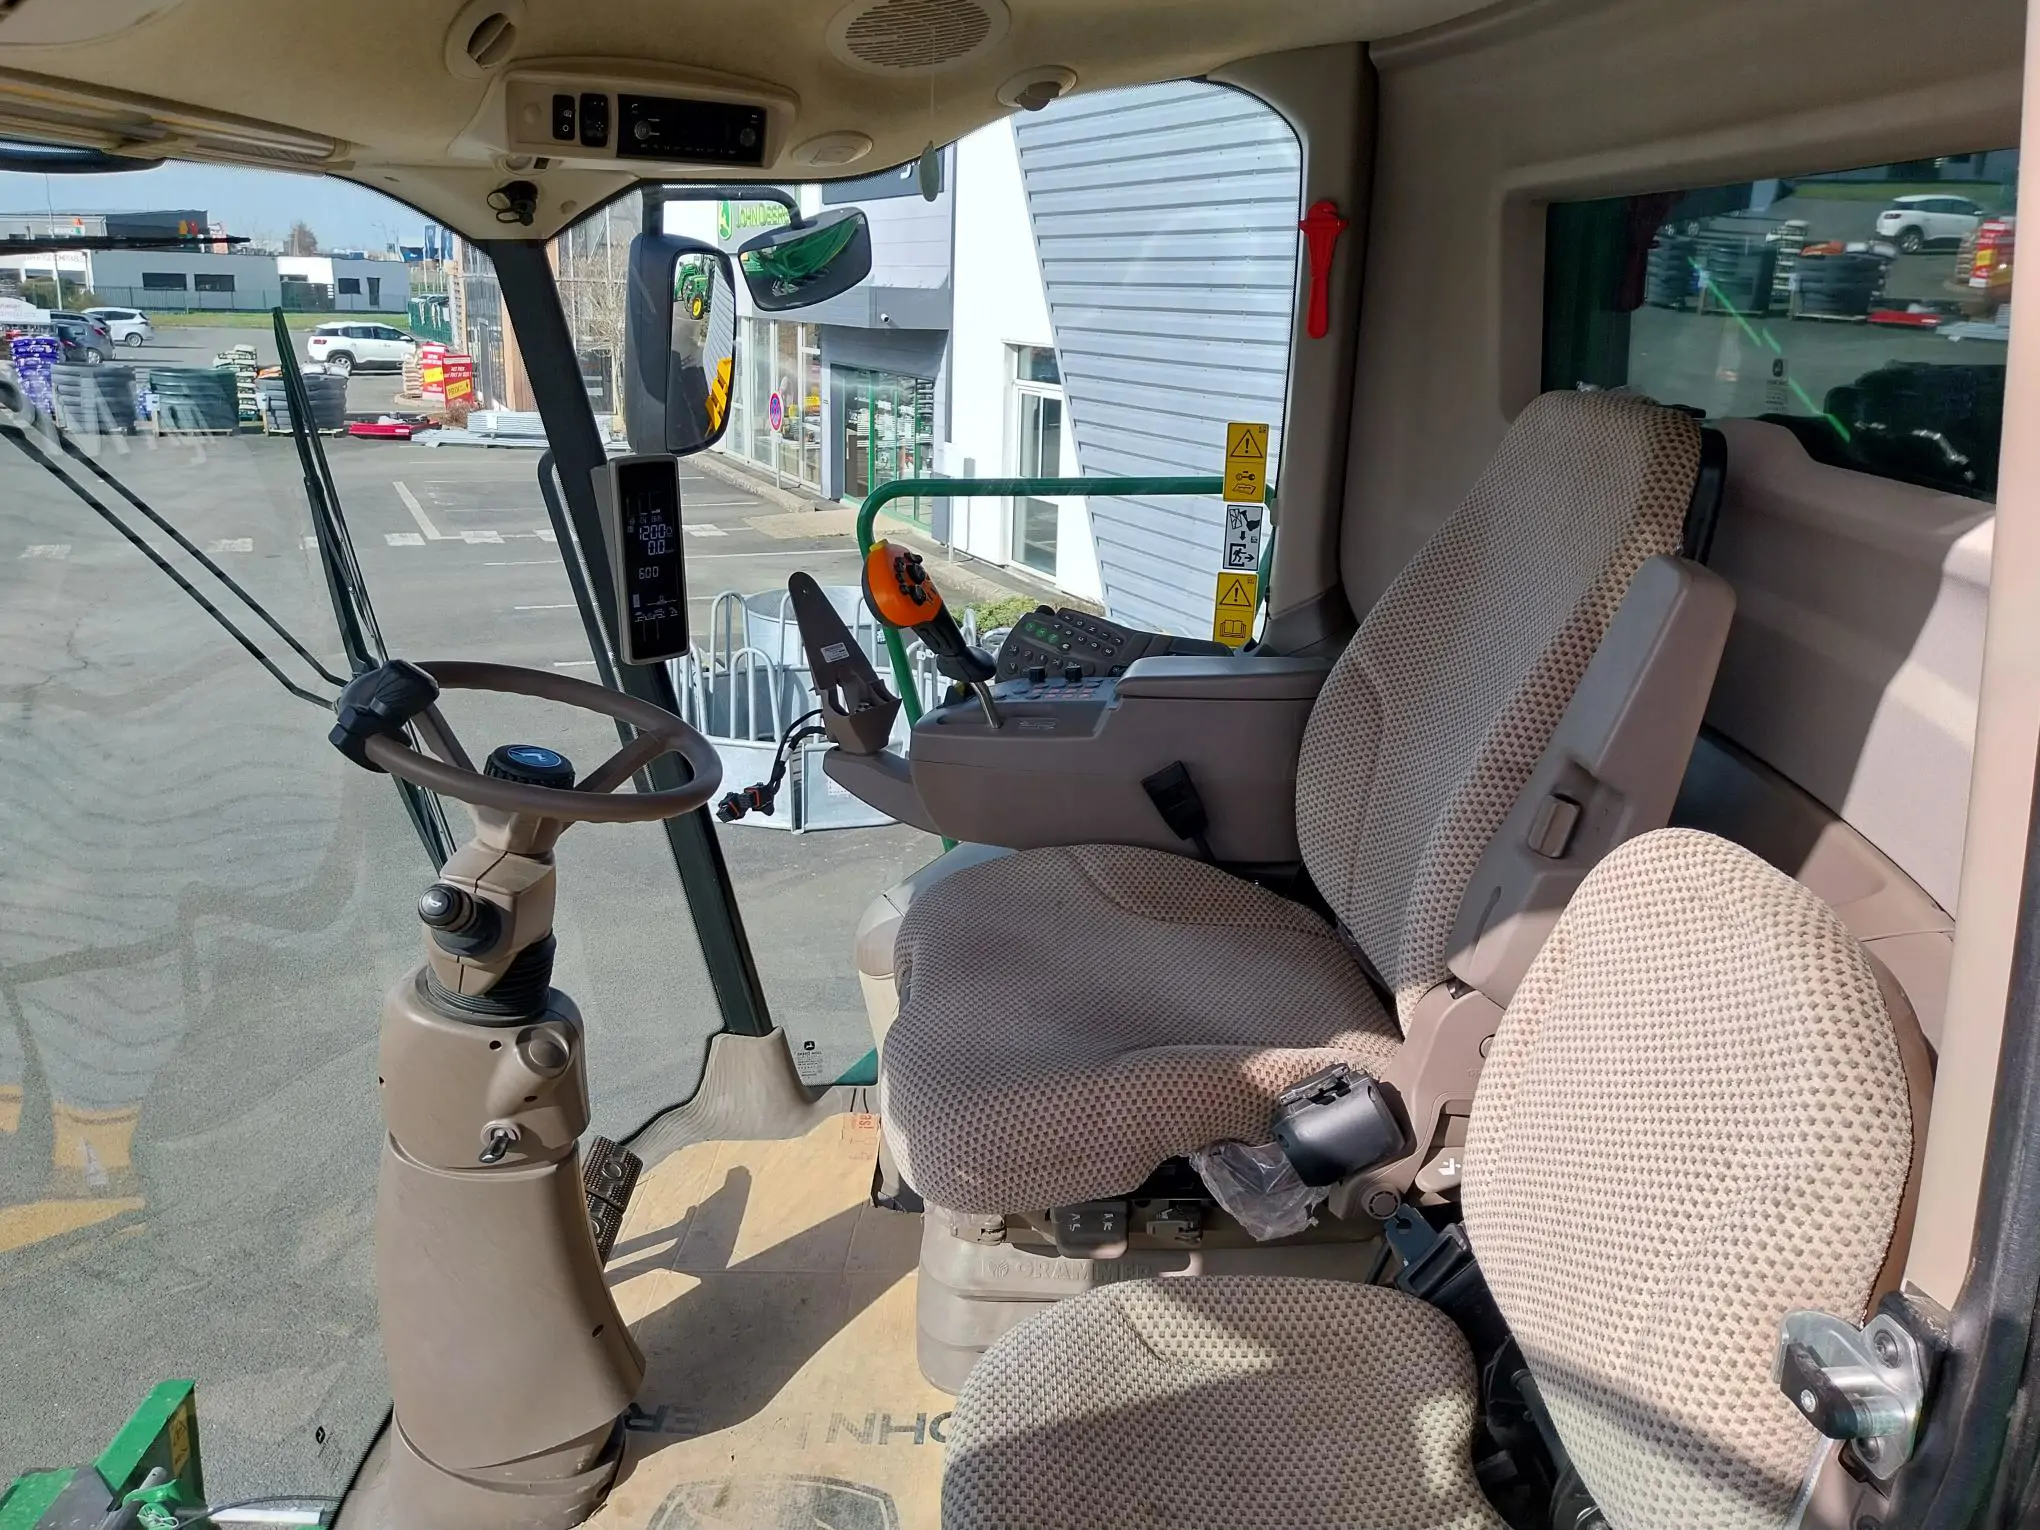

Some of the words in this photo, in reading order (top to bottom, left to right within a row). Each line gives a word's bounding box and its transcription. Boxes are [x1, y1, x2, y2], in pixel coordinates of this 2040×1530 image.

[639, 523, 666, 541] 1200
[647, 539, 665, 556] 0.0
[638, 566, 659, 579] 600
[826, 1410, 953, 1446] OHN
